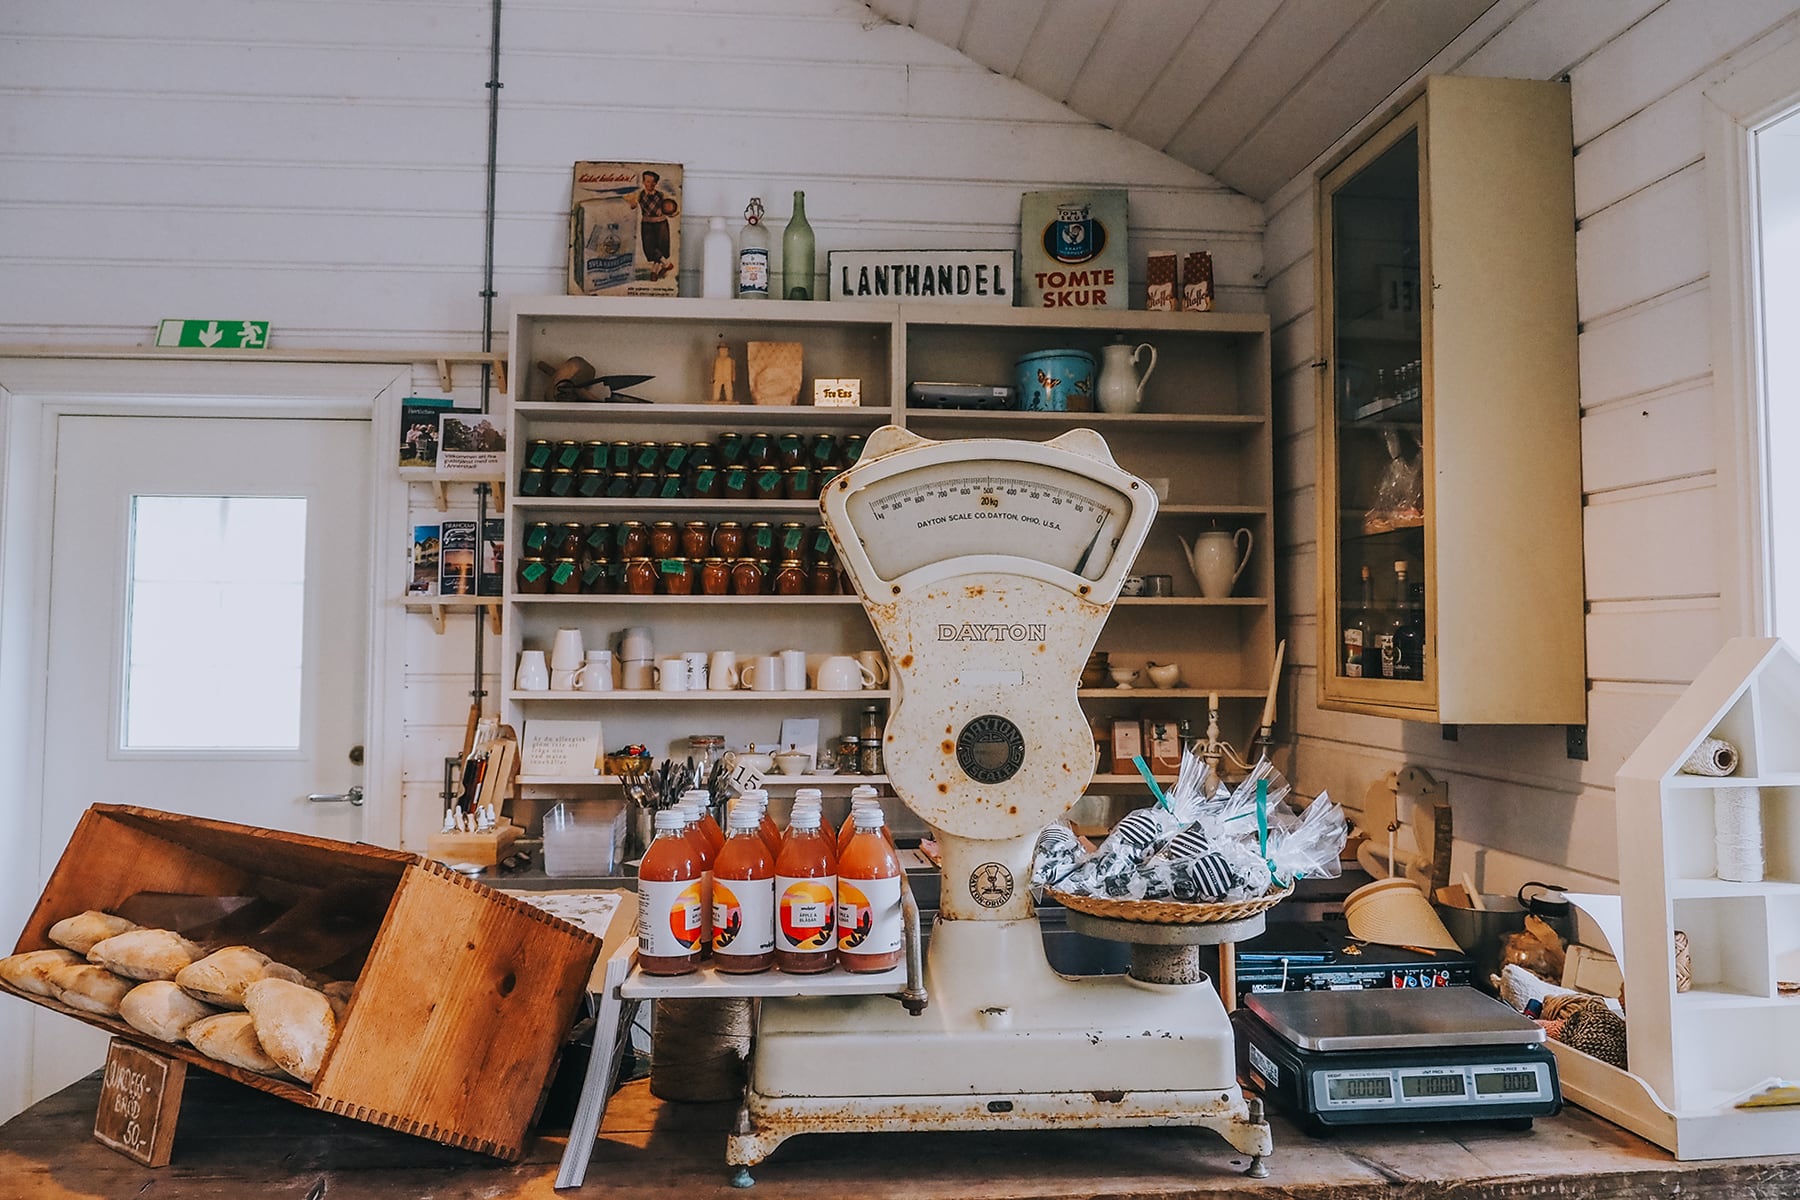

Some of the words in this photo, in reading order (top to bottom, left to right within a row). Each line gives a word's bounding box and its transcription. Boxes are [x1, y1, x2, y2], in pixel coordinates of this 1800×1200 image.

[842, 264, 1006, 297] LANTHANDEL
[1035, 269, 1114, 289] TOMTE
[1043, 290, 1107, 308] SKUR
[937, 490, 948, 499] 700
[1006, 488, 1017, 496] 400
[1029, 492, 1040, 500] 300
[1052, 497, 1062, 505] 200
[1096, 514, 1103, 524] 0
[917, 516, 947, 529] DAYTON
[949, 513, 973, 522] SCALE
[938, 624, 1046, 641] DAYTON
[961, 717, 1020, 744] DAYTON
[733, 765, 760, 790] 15
[968, 764, 1015, 780] SCALE
[114, 1094, 140, 1119] BRÖD
